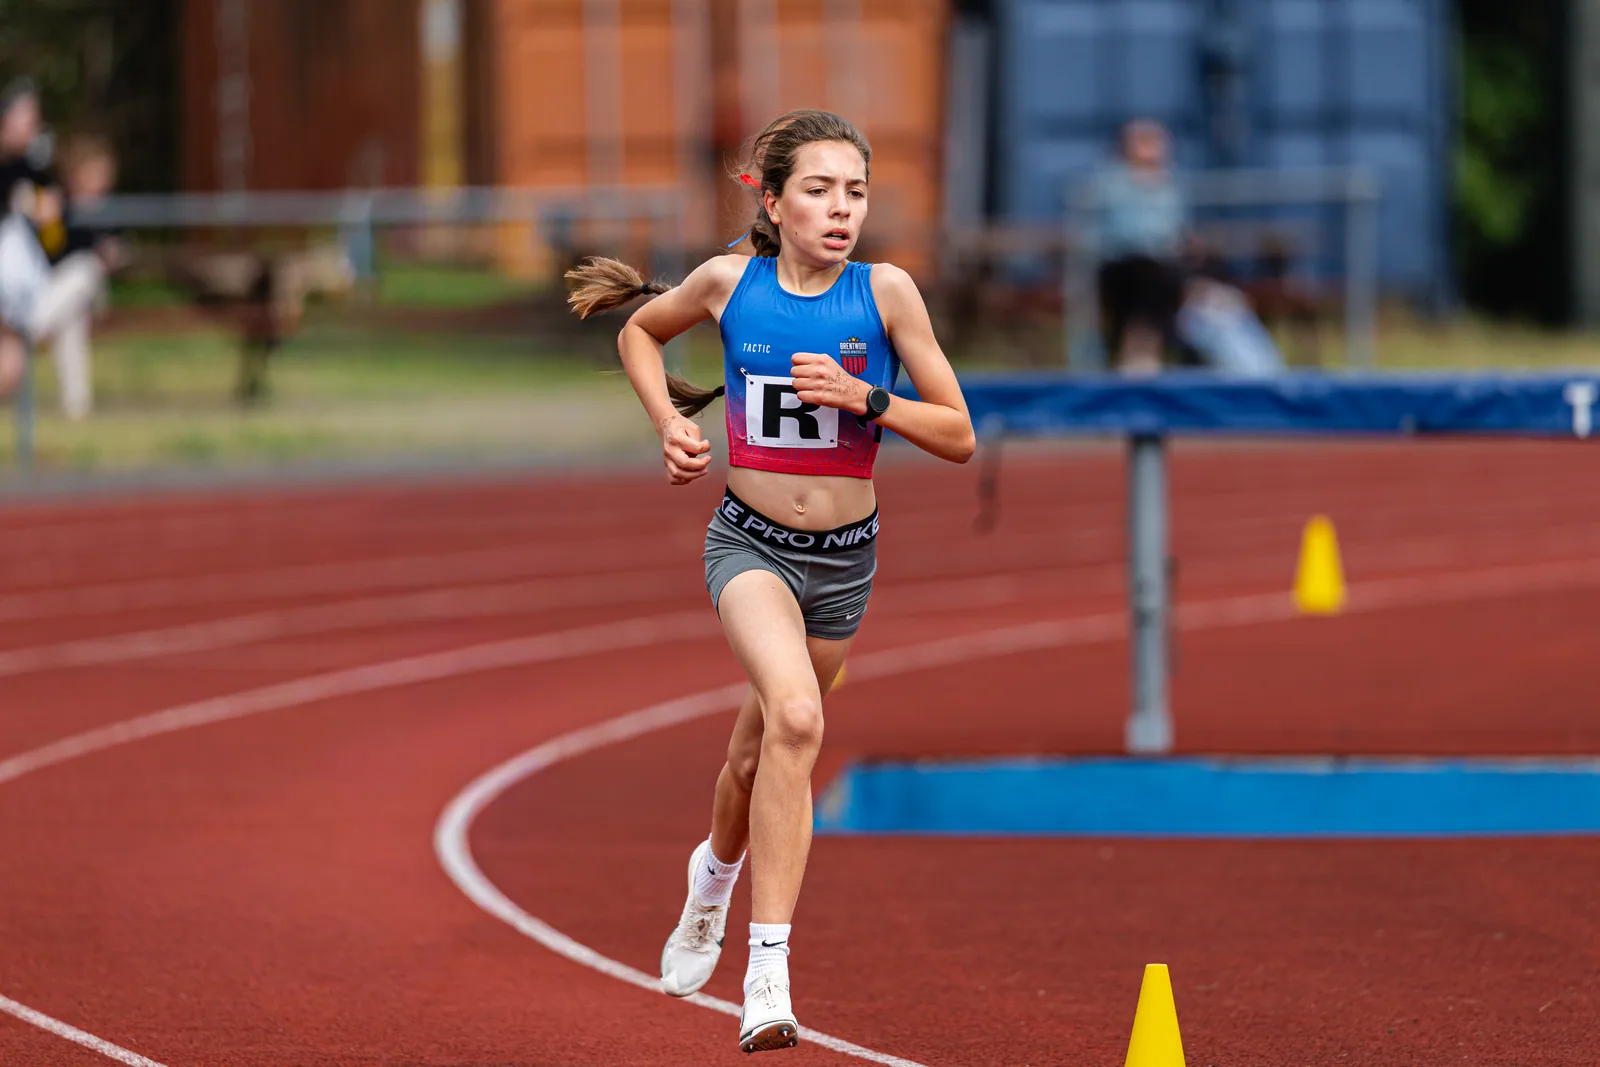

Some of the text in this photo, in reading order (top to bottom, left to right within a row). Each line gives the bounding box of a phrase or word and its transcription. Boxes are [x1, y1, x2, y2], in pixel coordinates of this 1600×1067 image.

[742, 342, 771, 354] TACTIC
[839, 342, 867, 350] BRENTWOOD
[762, 383, 822, 440] R
[742, 514, 815, 548] PRO
[822, 511, 880, 549] NIKE
